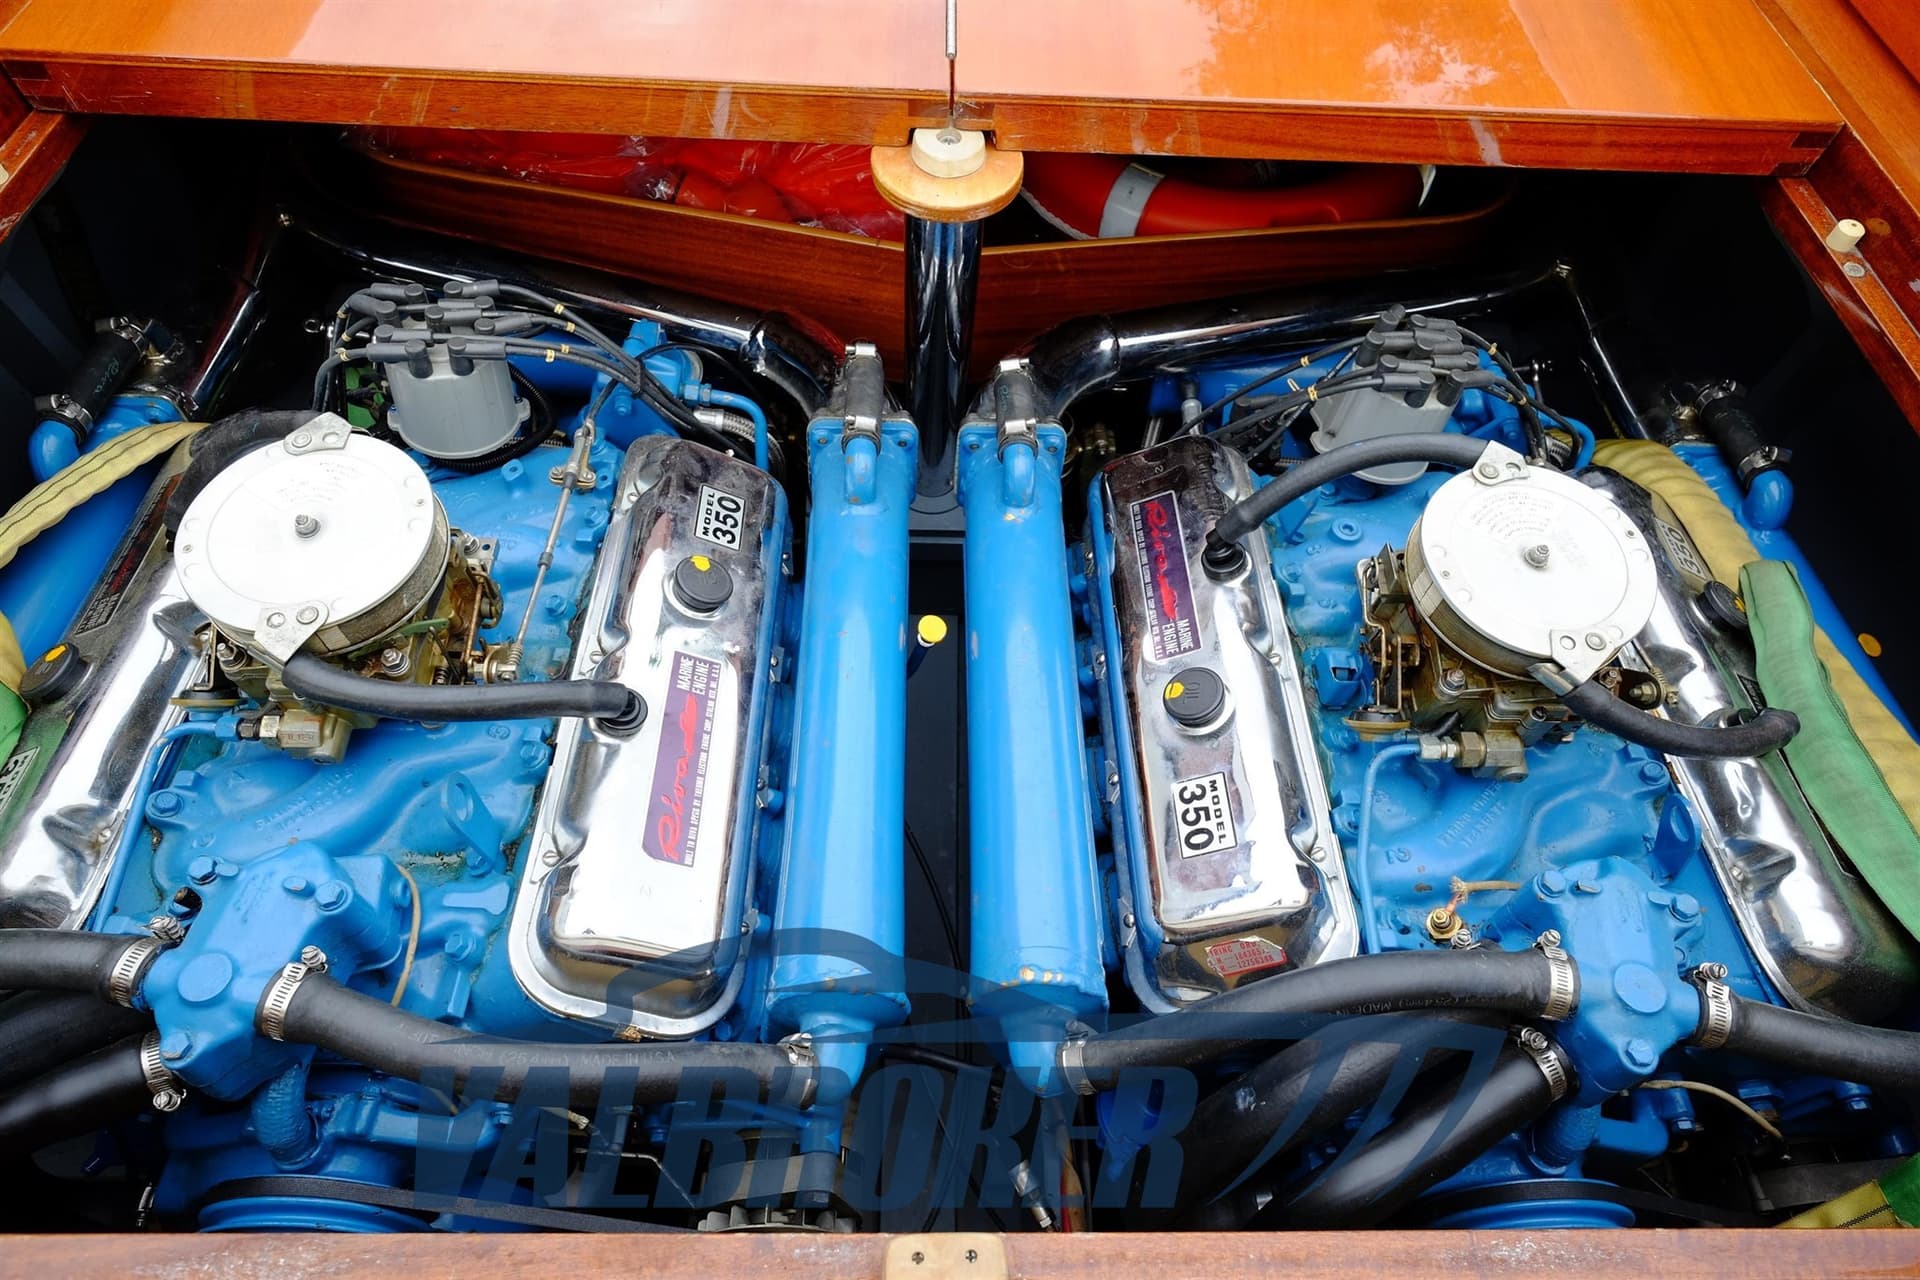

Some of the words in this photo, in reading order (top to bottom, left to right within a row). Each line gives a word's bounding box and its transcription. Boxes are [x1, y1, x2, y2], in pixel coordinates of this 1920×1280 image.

[701, 491, 715, 537] MODEL
[712, 496, 741, 544] 350
[1144, 500, 1171, 572] Riva
[1668, 526, 1701, 574] 350
[1162, 622, 1179, 656] ENGINE
[1176, 618, 1194, 652] MARINE
[676, 655, 694, 692] MARINE
[691, 659, 709, 696] ENGINE
[1185, 681, 1201, 702] OIL
[658, 756, 689, 862] Riva
[1179, 784, 1214, 850] 350
[1209, 779, 1226, 844] MODEL
